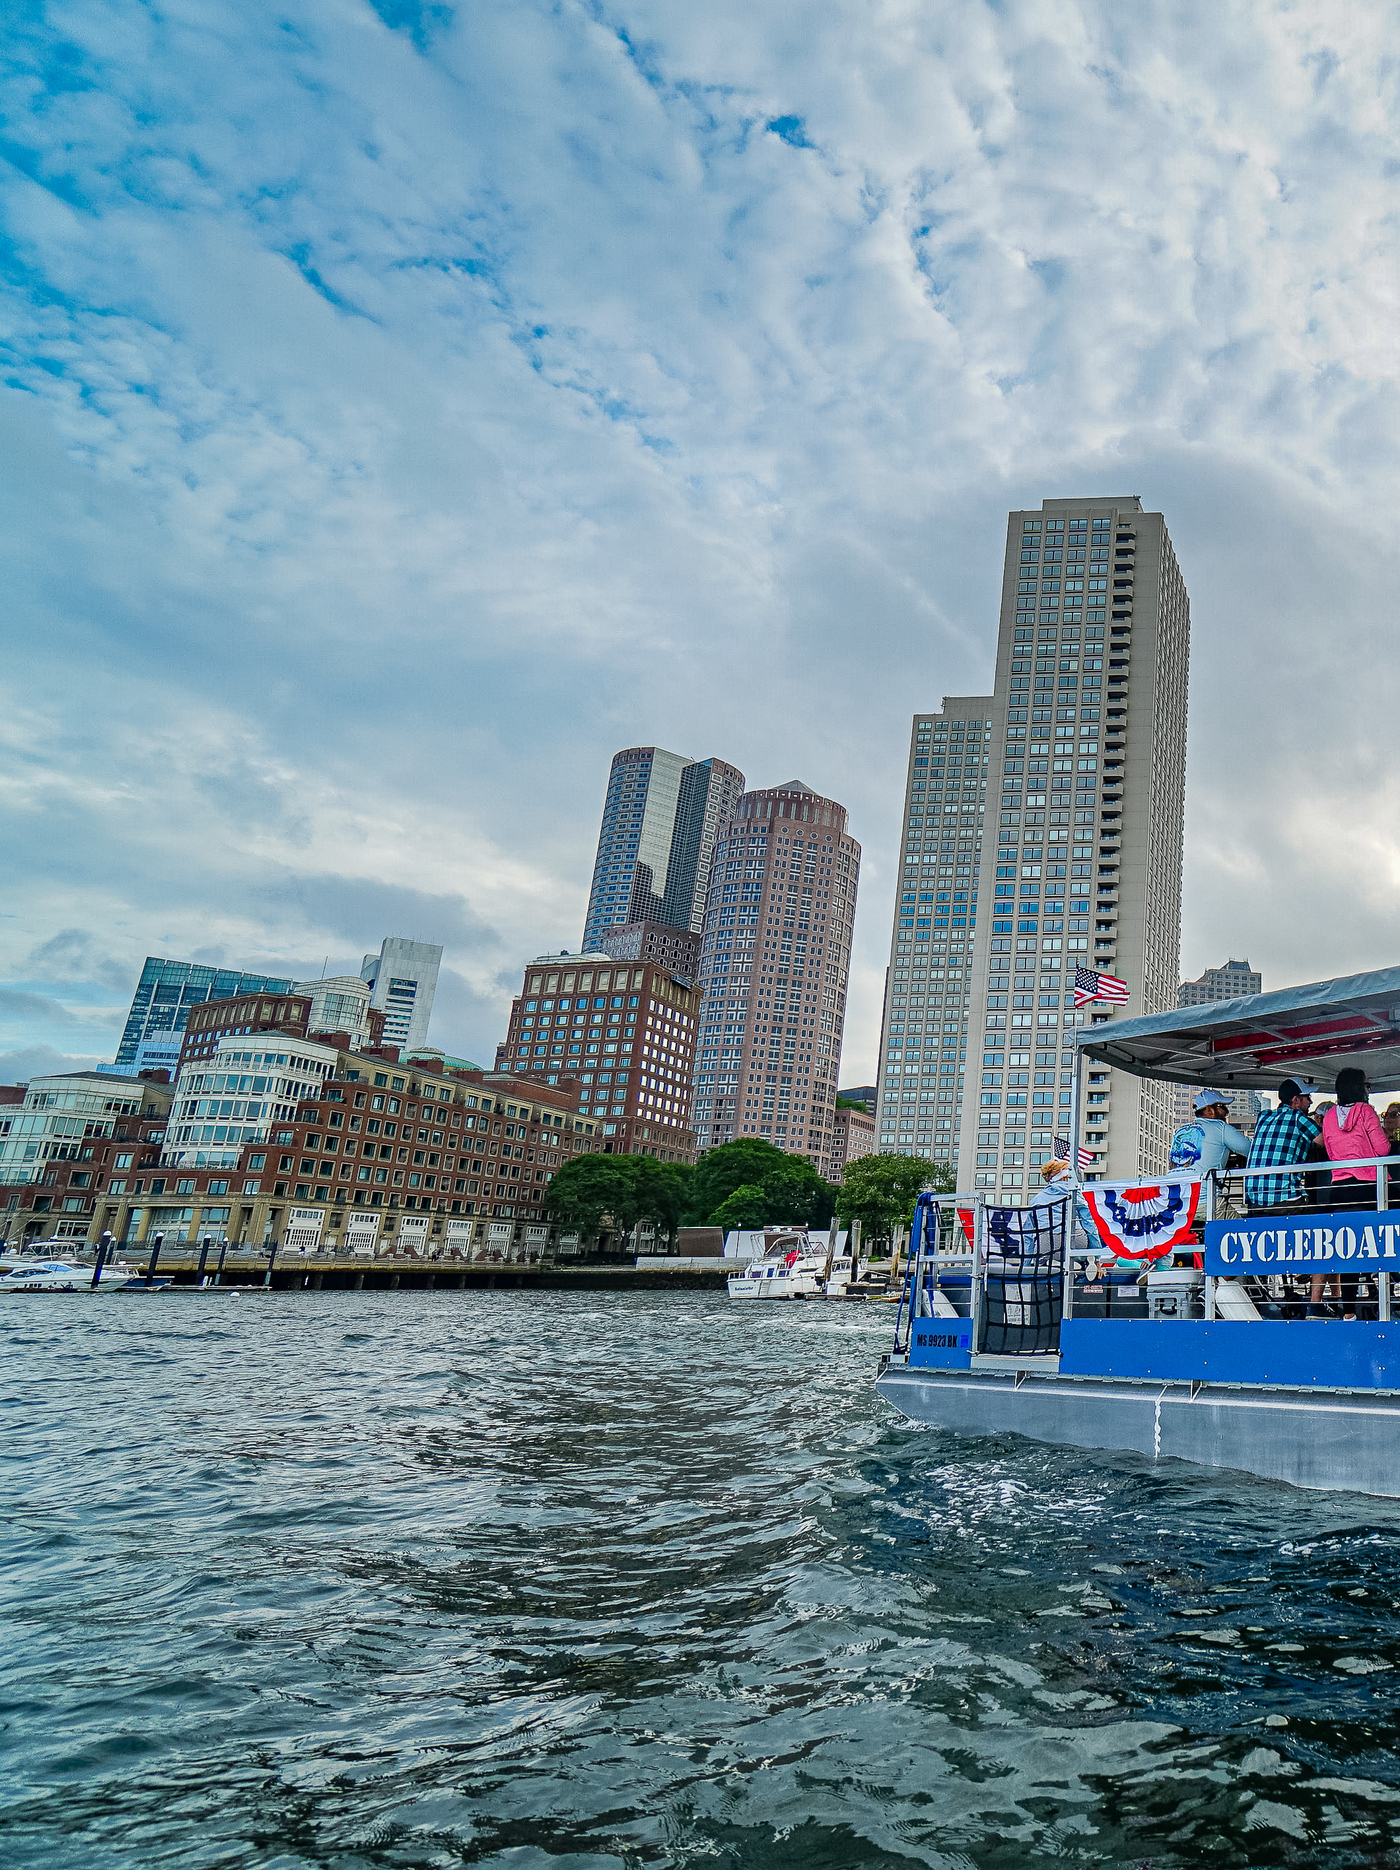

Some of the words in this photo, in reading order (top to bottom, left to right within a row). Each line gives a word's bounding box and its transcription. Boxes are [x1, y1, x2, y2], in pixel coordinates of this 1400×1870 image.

[1219, 1223, 1400, 1263] CYCLEBOAT
[916, 1334, 928, 1347] MS
[928, 1334, 946, 1348] 9923
[947, 1334, 958, 1348] BK
